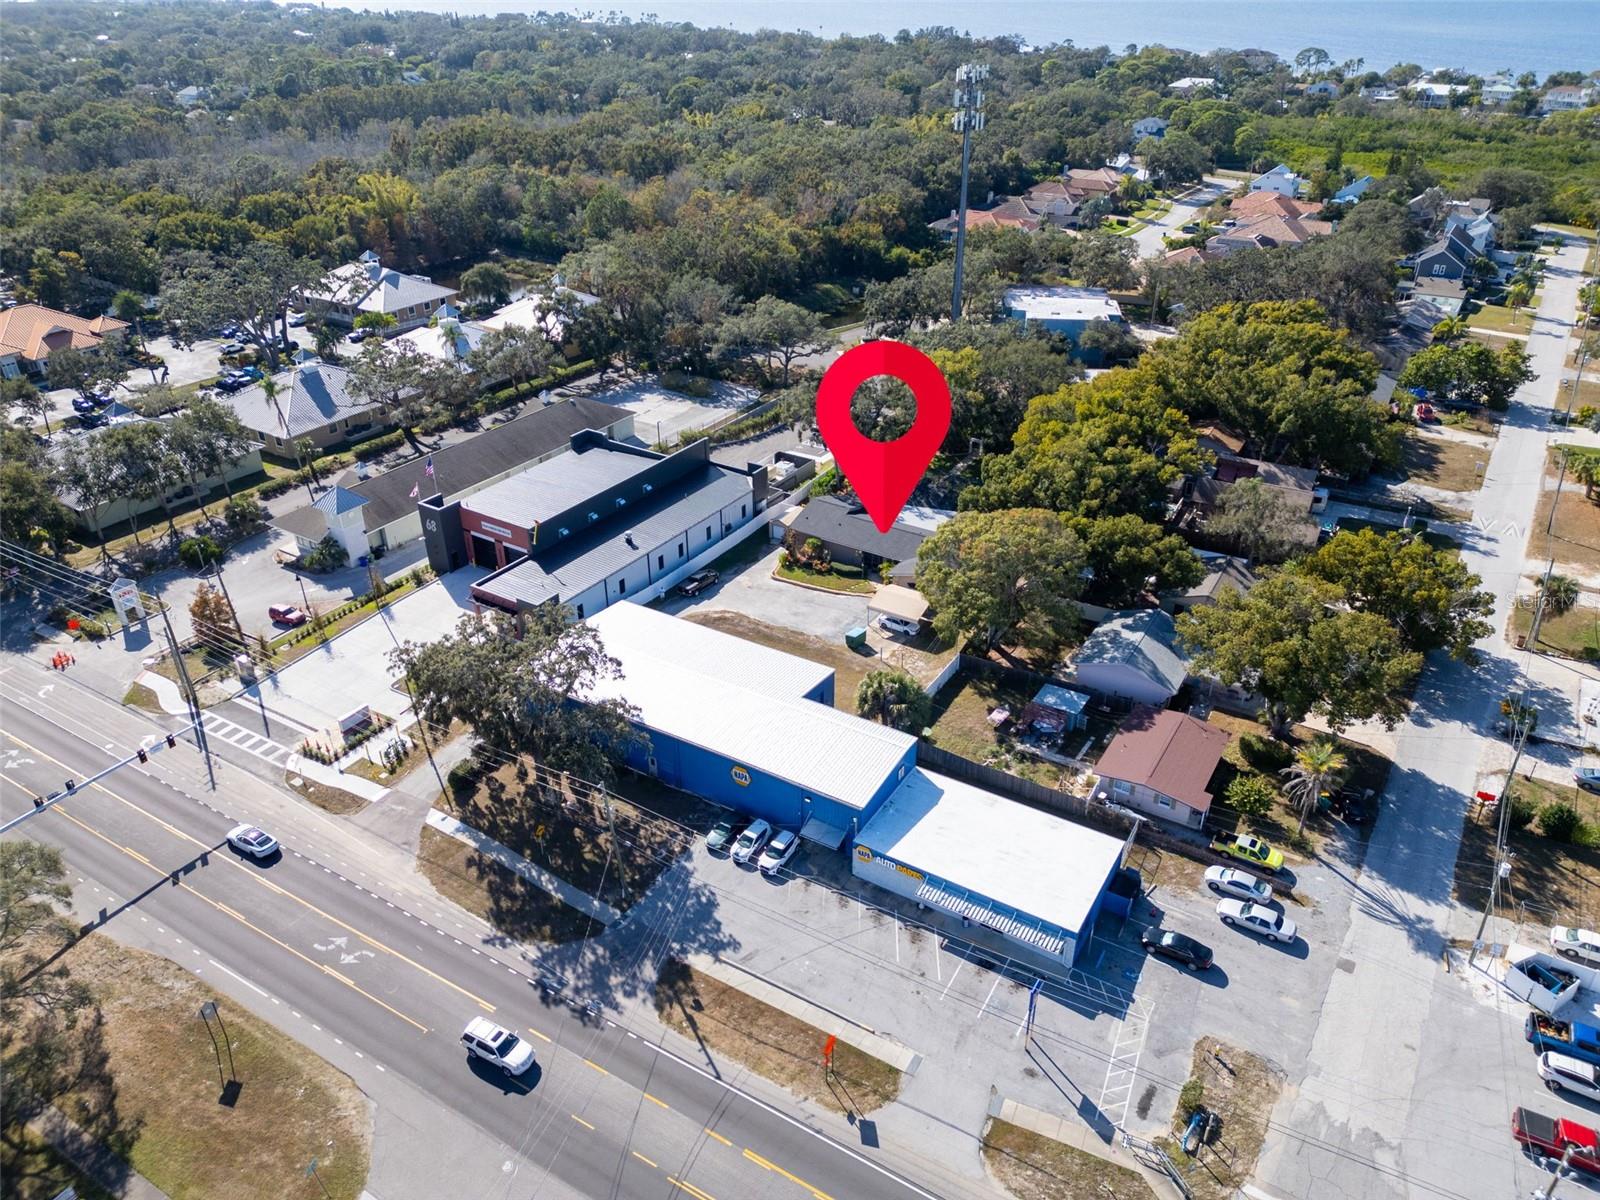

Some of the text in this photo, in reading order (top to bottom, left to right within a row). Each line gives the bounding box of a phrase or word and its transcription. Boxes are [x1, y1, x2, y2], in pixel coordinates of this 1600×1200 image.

[426, 518, 437, 532] 68
[733, 770, 749, 783] NAPA
[857, 849, 871, 860] NAPA
[875, 856, 896, 870] AUTO
